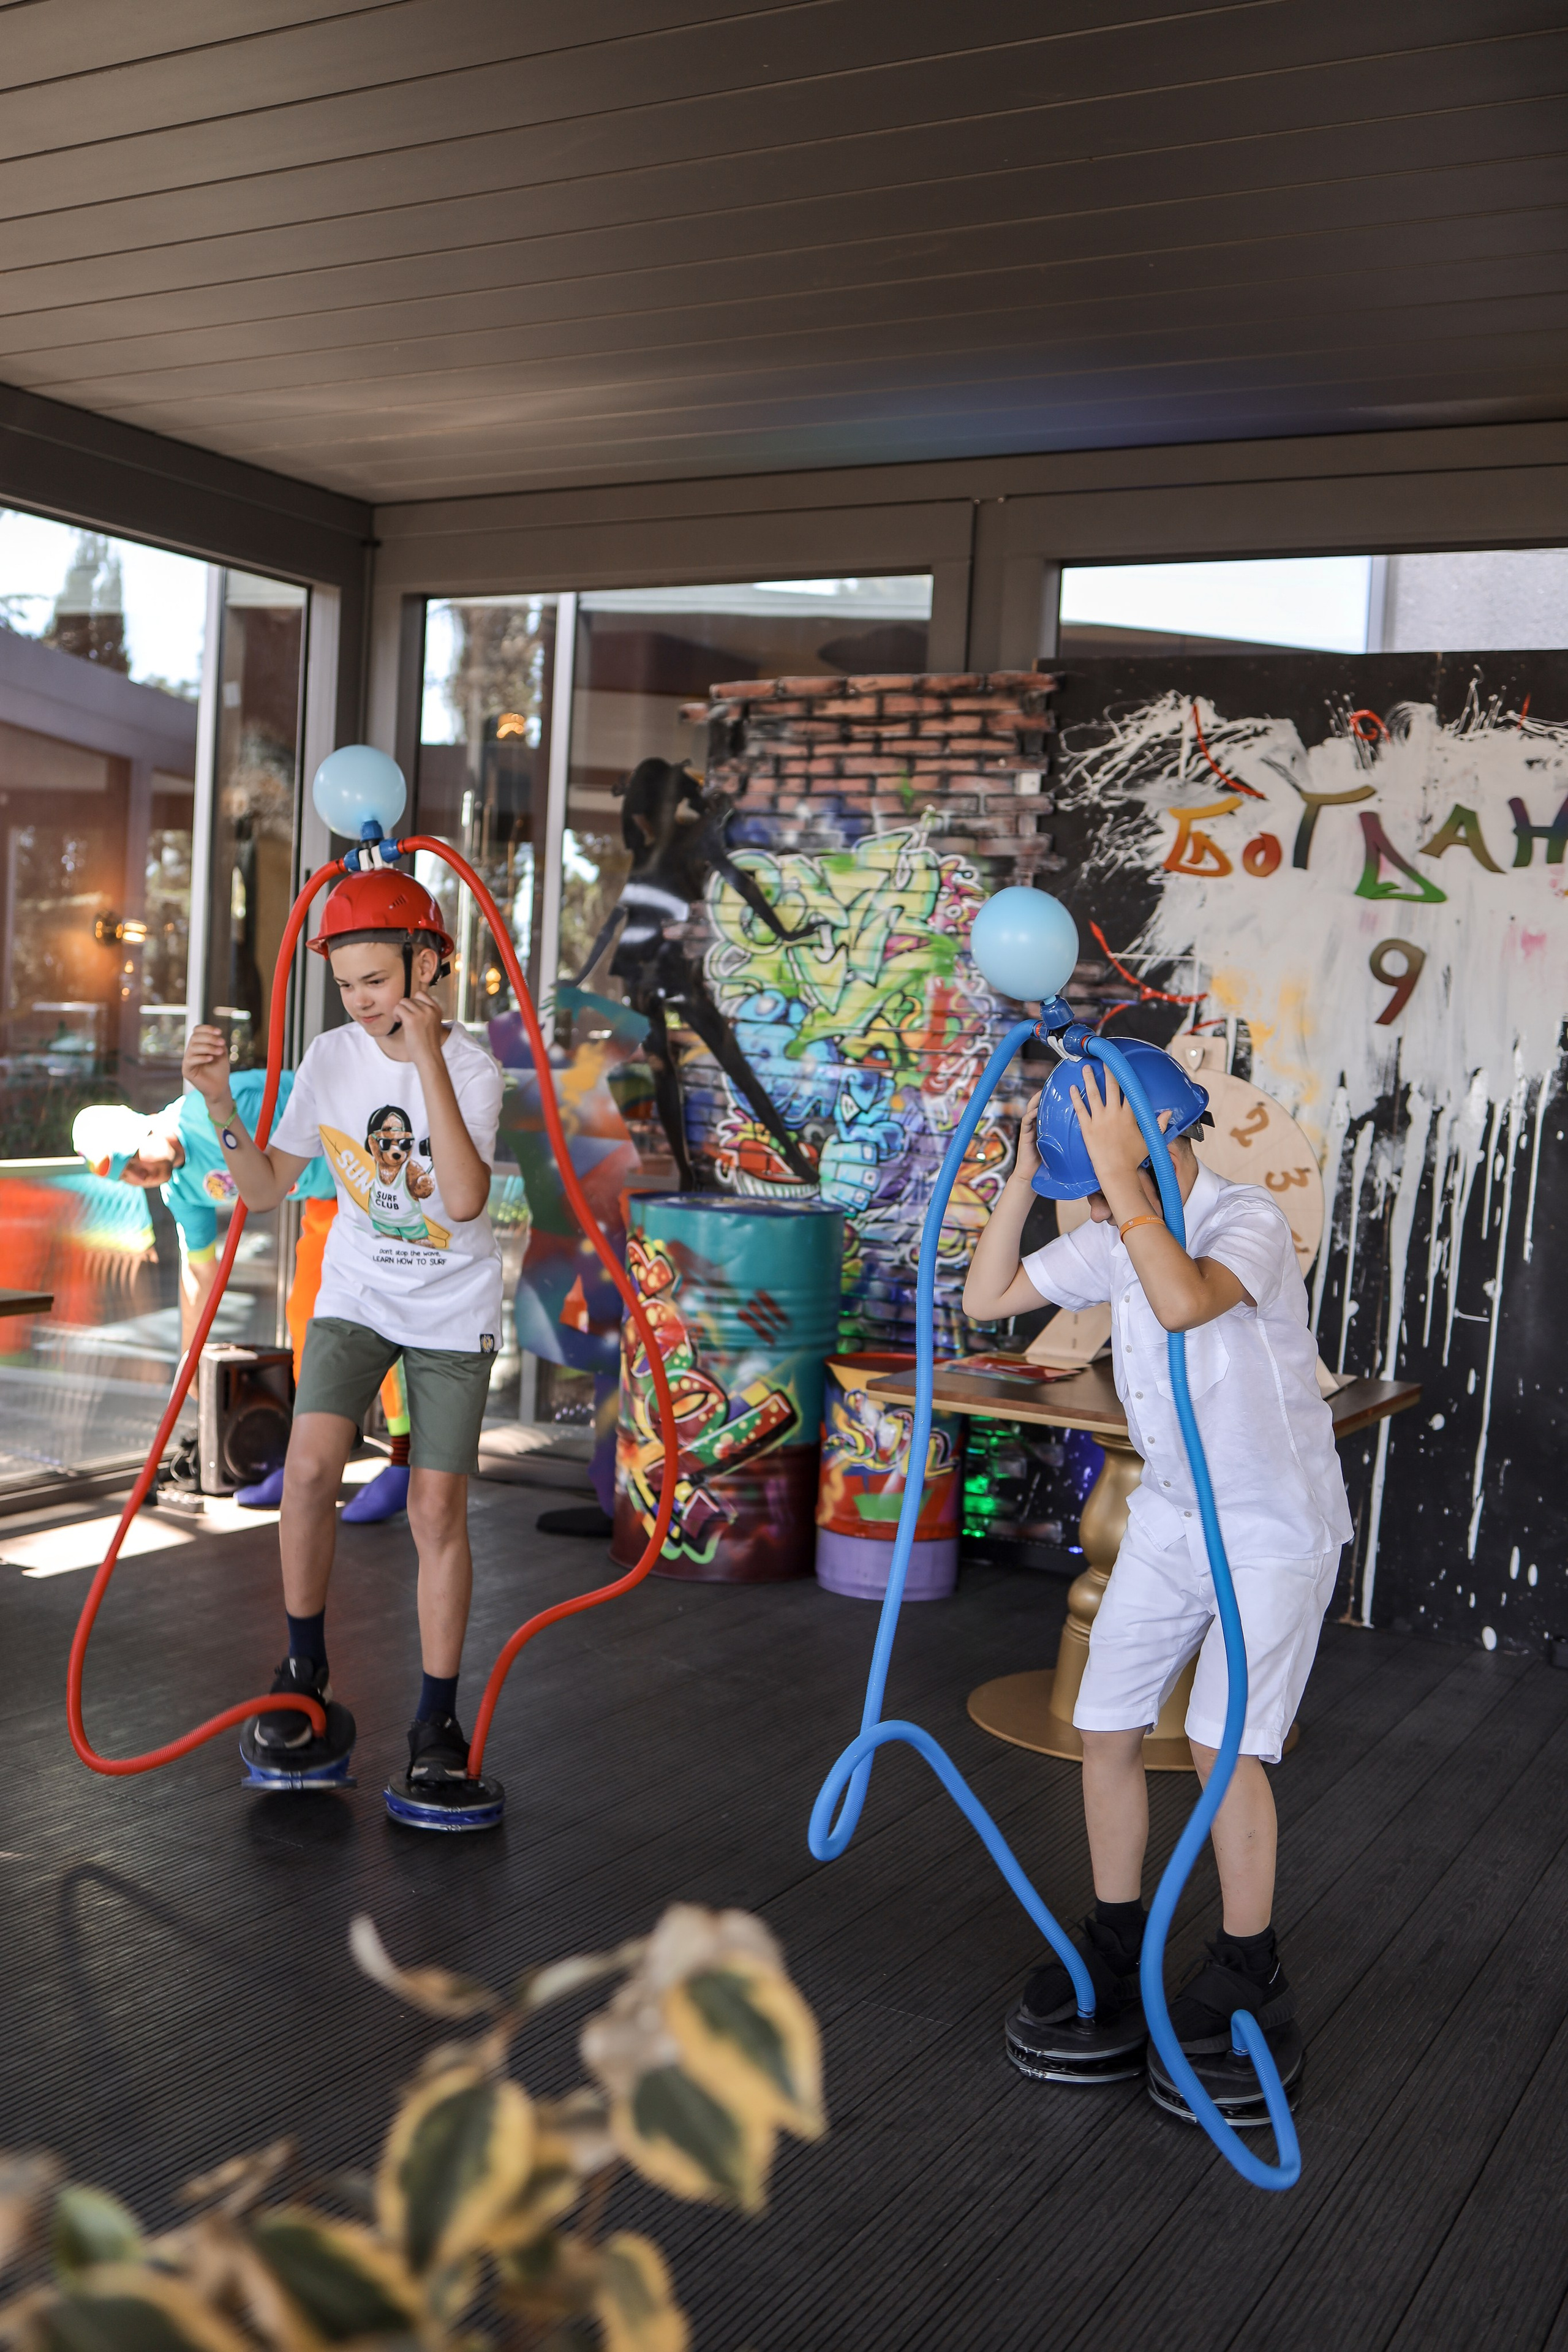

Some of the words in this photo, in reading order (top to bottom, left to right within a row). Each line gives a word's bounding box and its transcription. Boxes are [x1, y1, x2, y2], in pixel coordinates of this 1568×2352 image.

[1370, 939, 1427, 1025] 9
[1230, 1103, 1270, 1148] 2
[336, 1149, 375, 1195] SUN
[1265, 1167, 1310, 1192] 3
[375, 1199, 399, 1210] CLUB
[377, 1191, 397, 1202] SURF
[372, 1255, 394, 1264] LEARN
